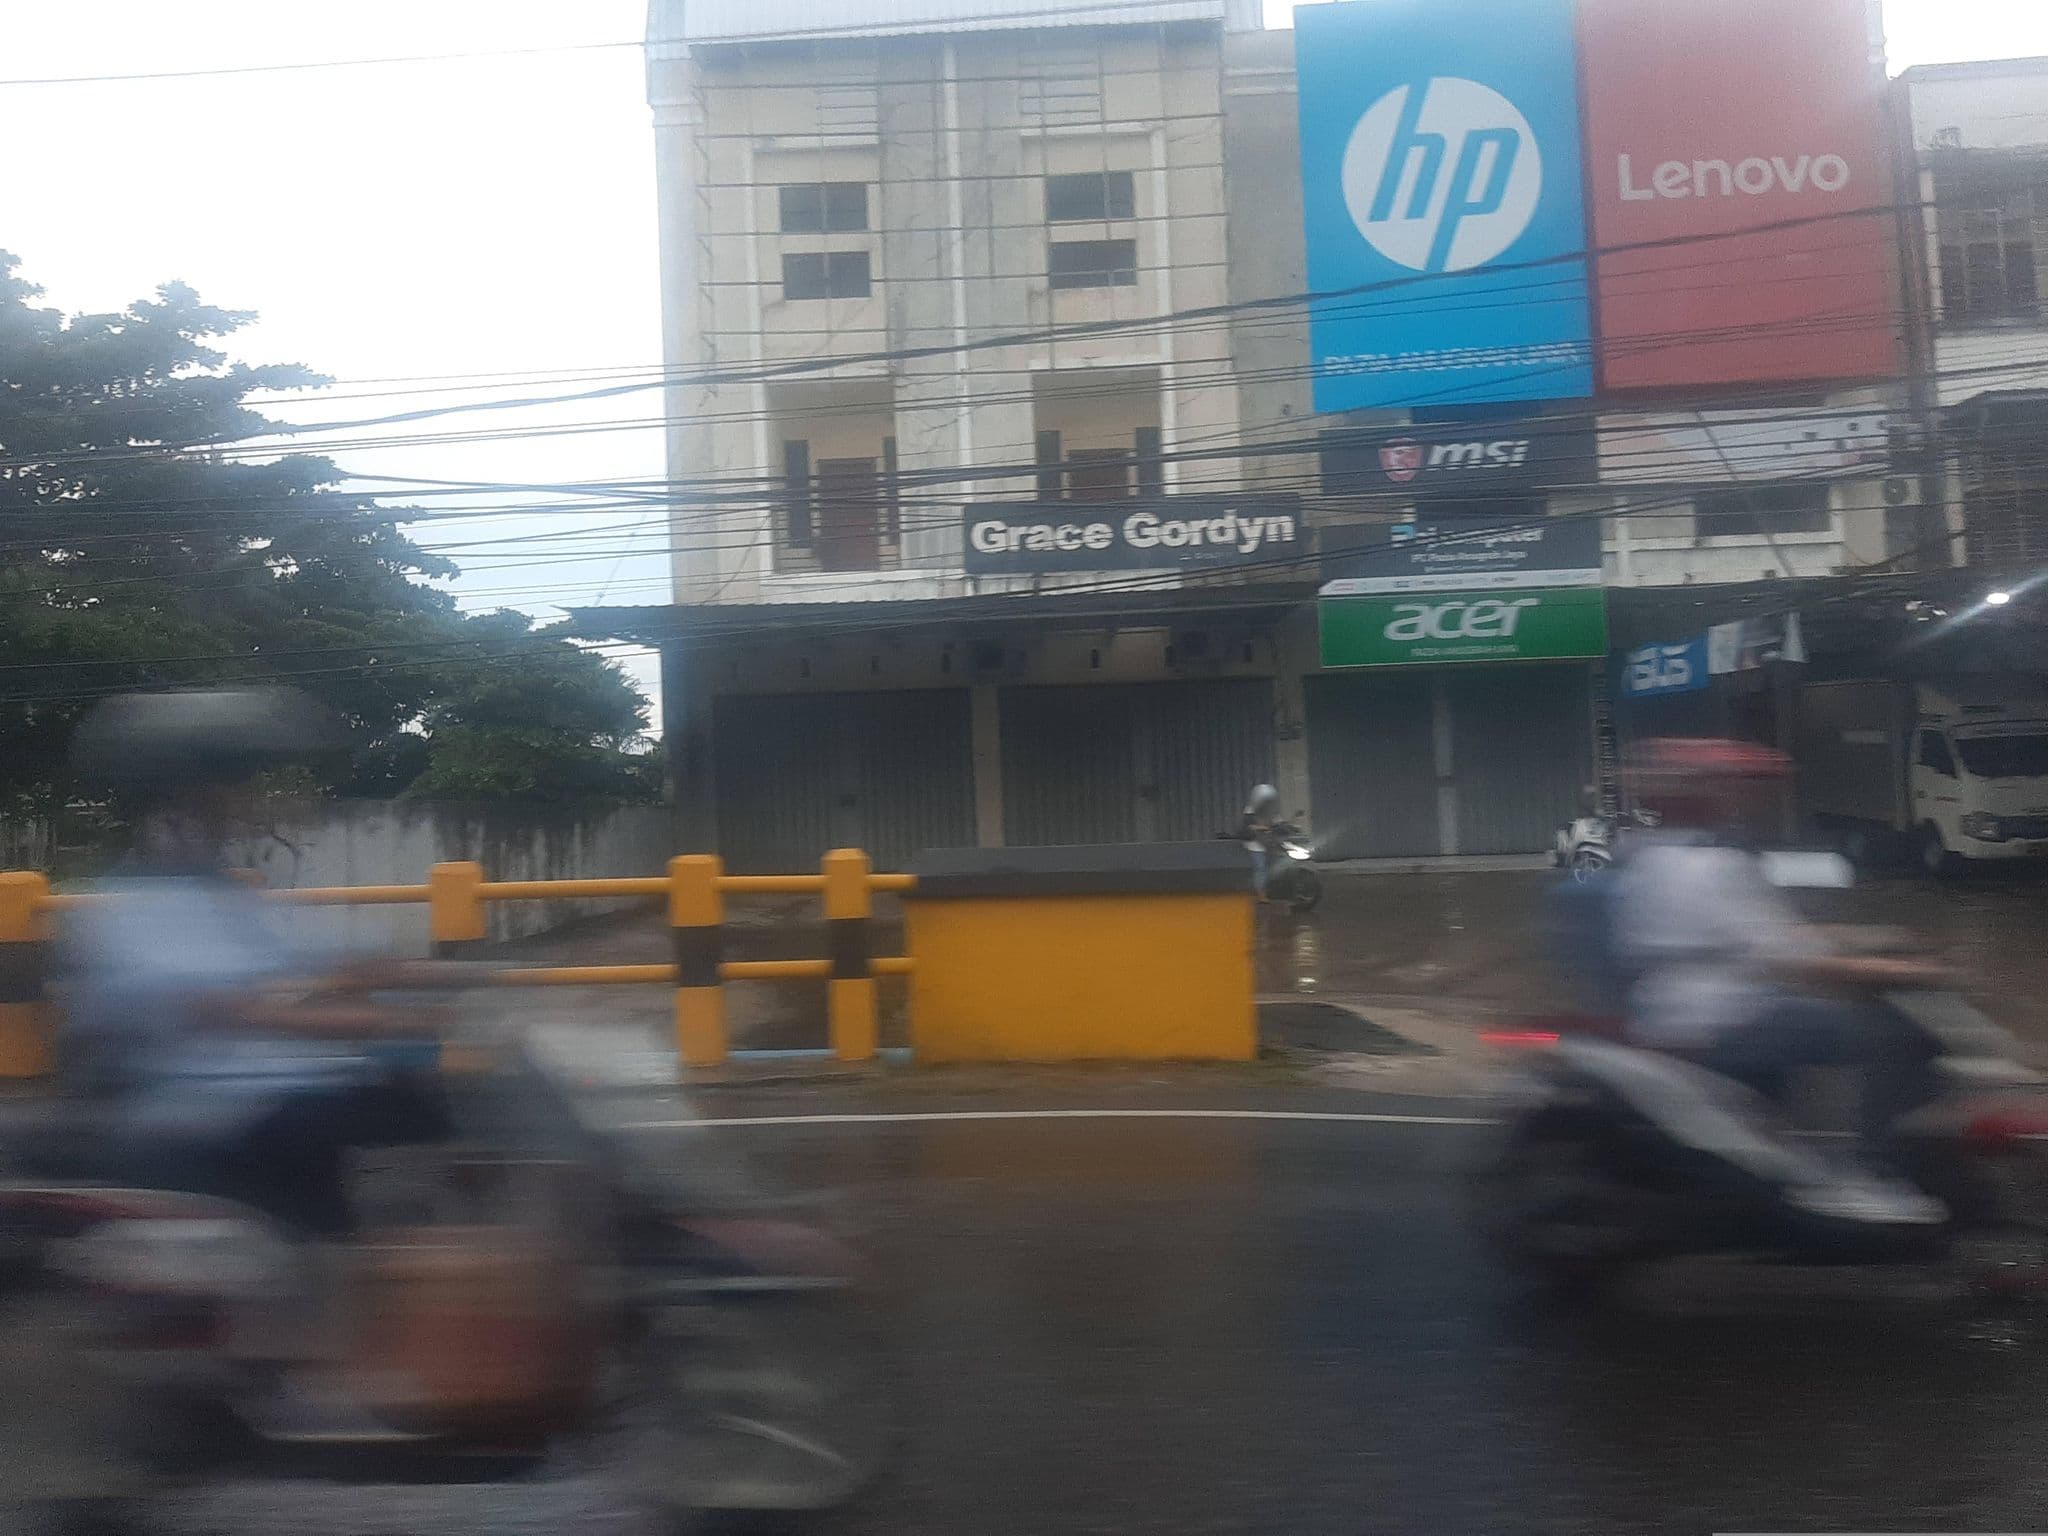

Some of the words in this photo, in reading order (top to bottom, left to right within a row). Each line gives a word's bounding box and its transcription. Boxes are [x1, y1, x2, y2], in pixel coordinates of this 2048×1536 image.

[1367, 77, 1523, 272] hp
[1619, 154, 1849, 200] Lenovo
[1426, 440, 1529, 471] msi
[971, 520, 1114, 553] Grace
[1123, 509, 1296, 553] Gordyn
[1384, 599, 1541, 641] acer
